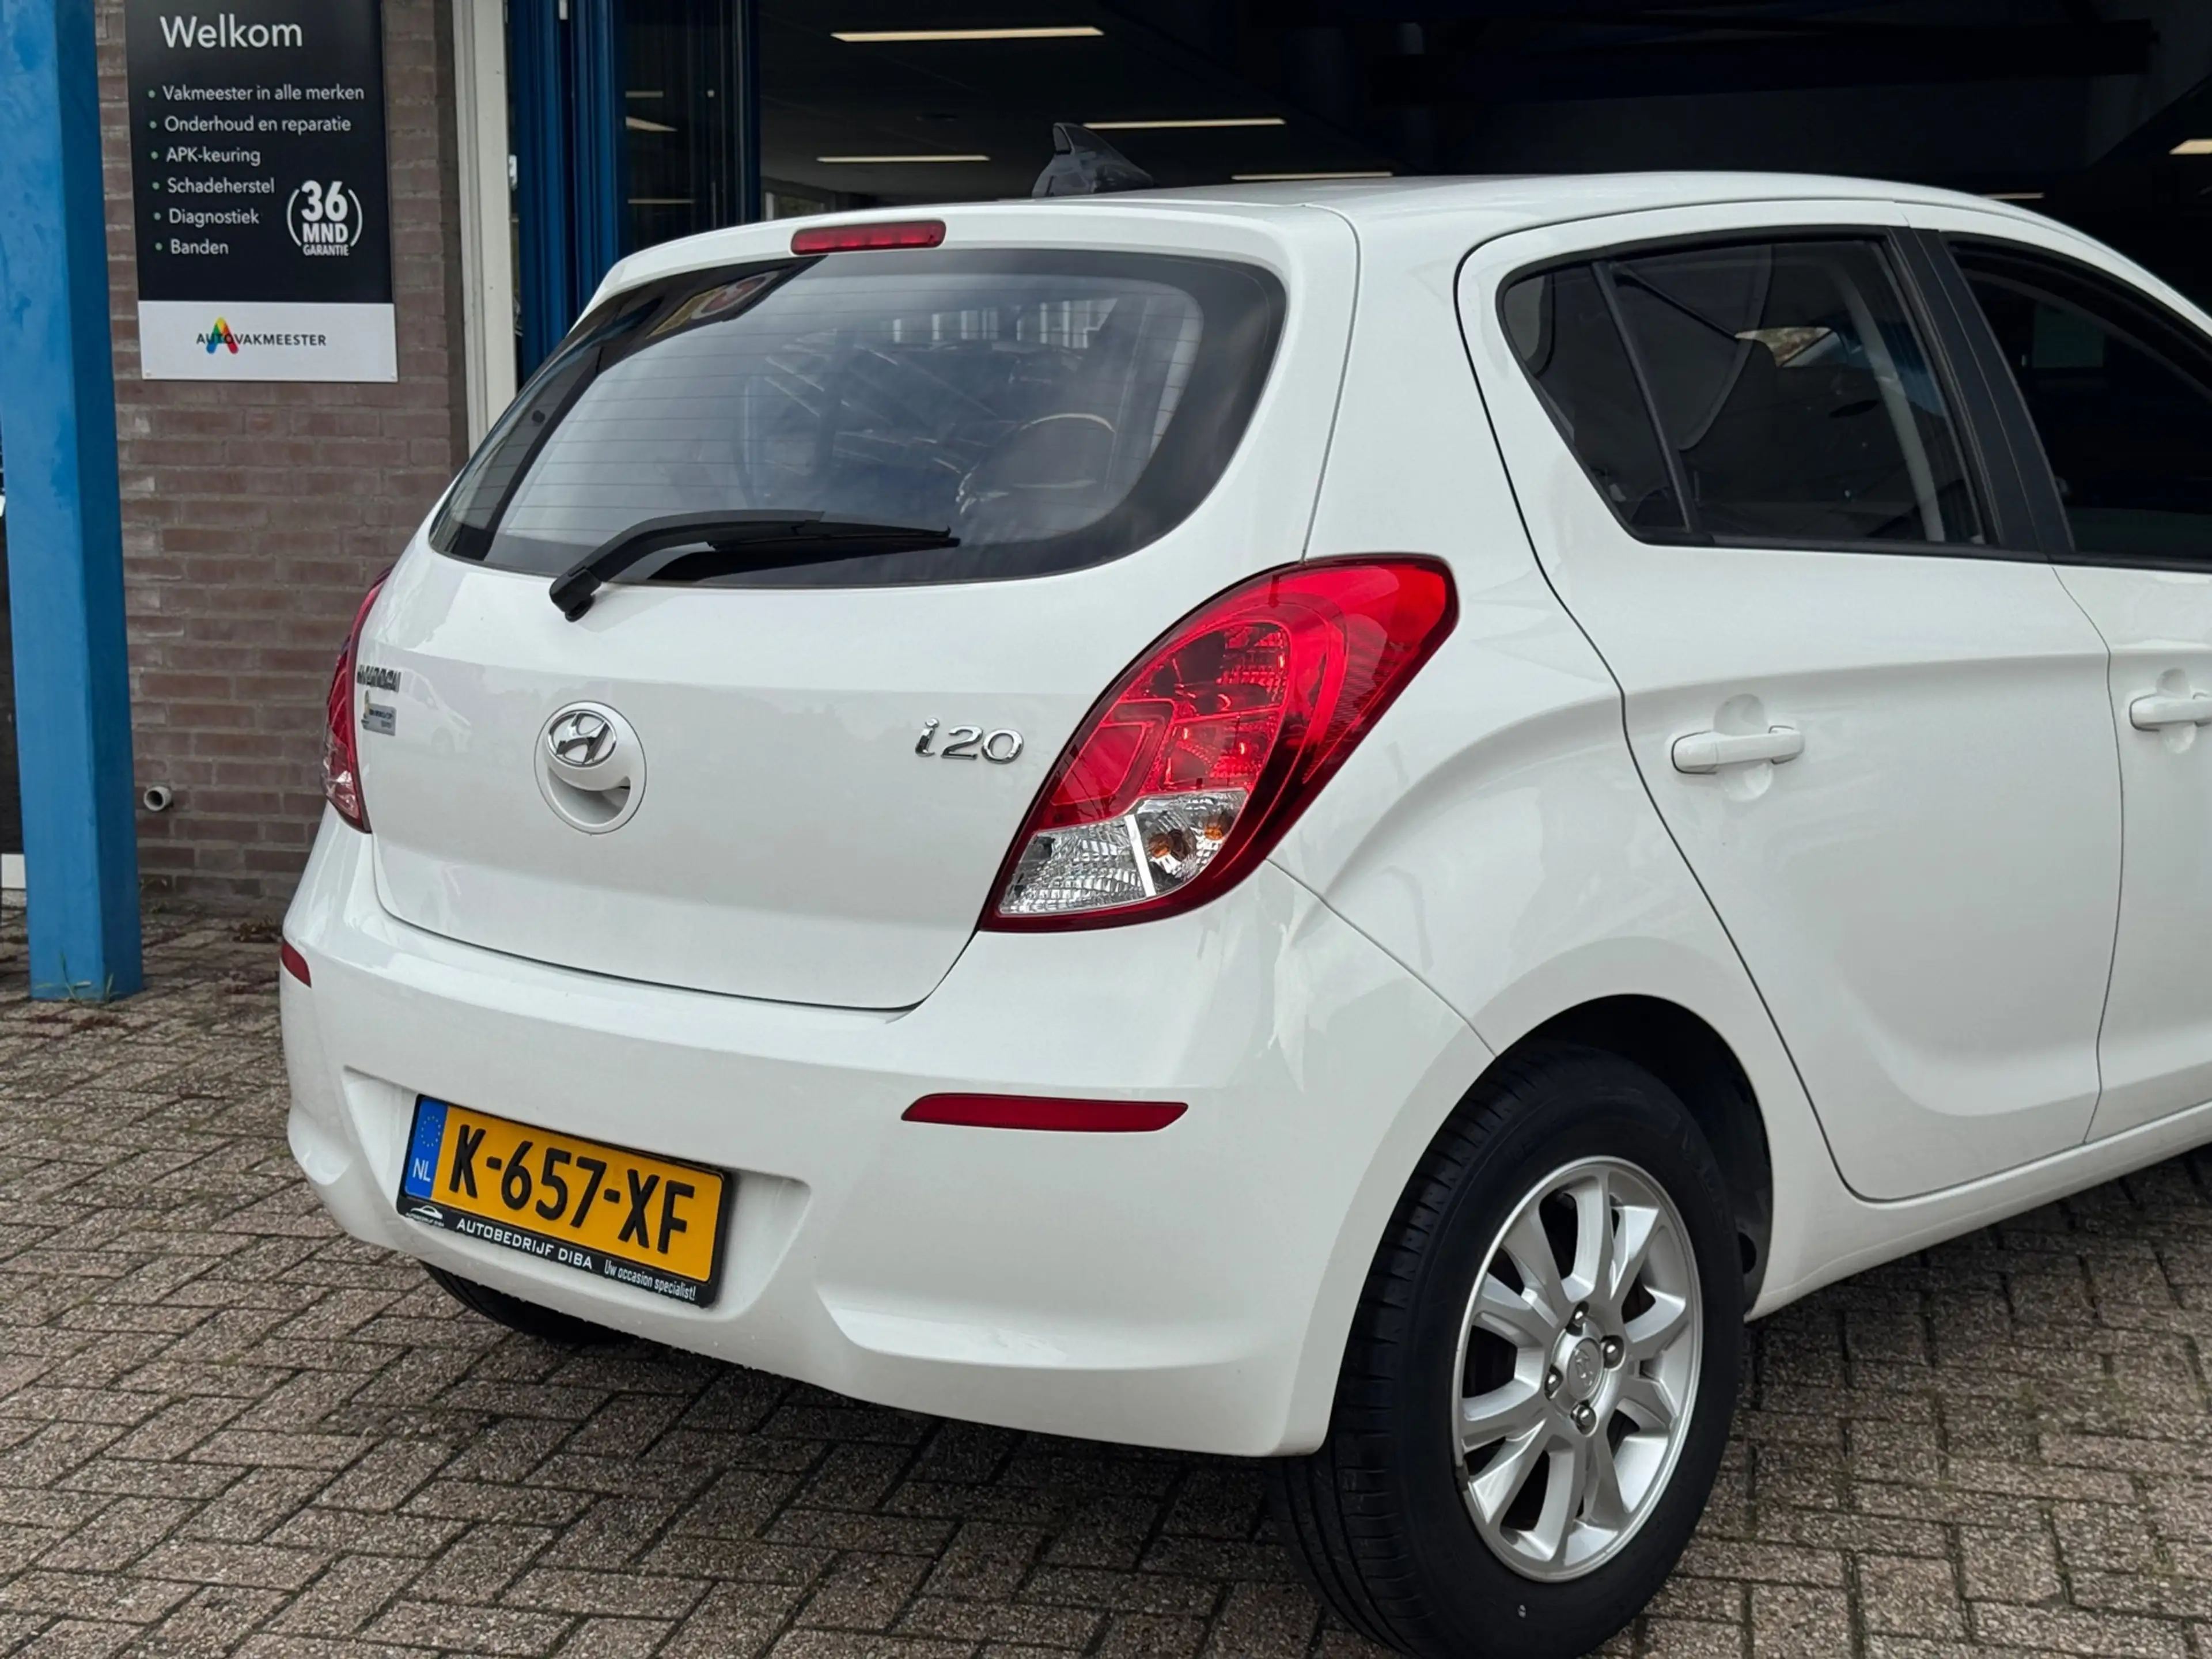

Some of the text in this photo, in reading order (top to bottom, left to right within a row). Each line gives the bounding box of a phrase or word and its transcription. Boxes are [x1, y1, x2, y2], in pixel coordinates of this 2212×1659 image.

[159, 12, 303, 48] Welkom
[162, 84, 364, 101] Vakmeester in alle merken
[165, 115, 351, 135] Onderhoud en reparatie
[166, 146, 261, 166] APK-keuring
[167, 177, 275, 194] Schadeherstel
[301, 180, 348, 222] 36
[169, 208, 259, 228] Diagnostiek
[302, 222, 349, 243] MND
[171, 238, 229, 255] Banden
[303, 244, 349, 256] GARANTIE
[196, 332, 327, 346] AUTOVAKMEESTER
[915, 718, 1024, 765] i20
[412, 1157, 431, 1182] NL
[449, 1123, 695, 1255] K-657-XF
[456, 1217, 555, 1256] AUTOBEDRIJF
[557, 1247, 593, 1270] DIBA
[604, 1259, 696, 1301] Uw occasion specialist!
